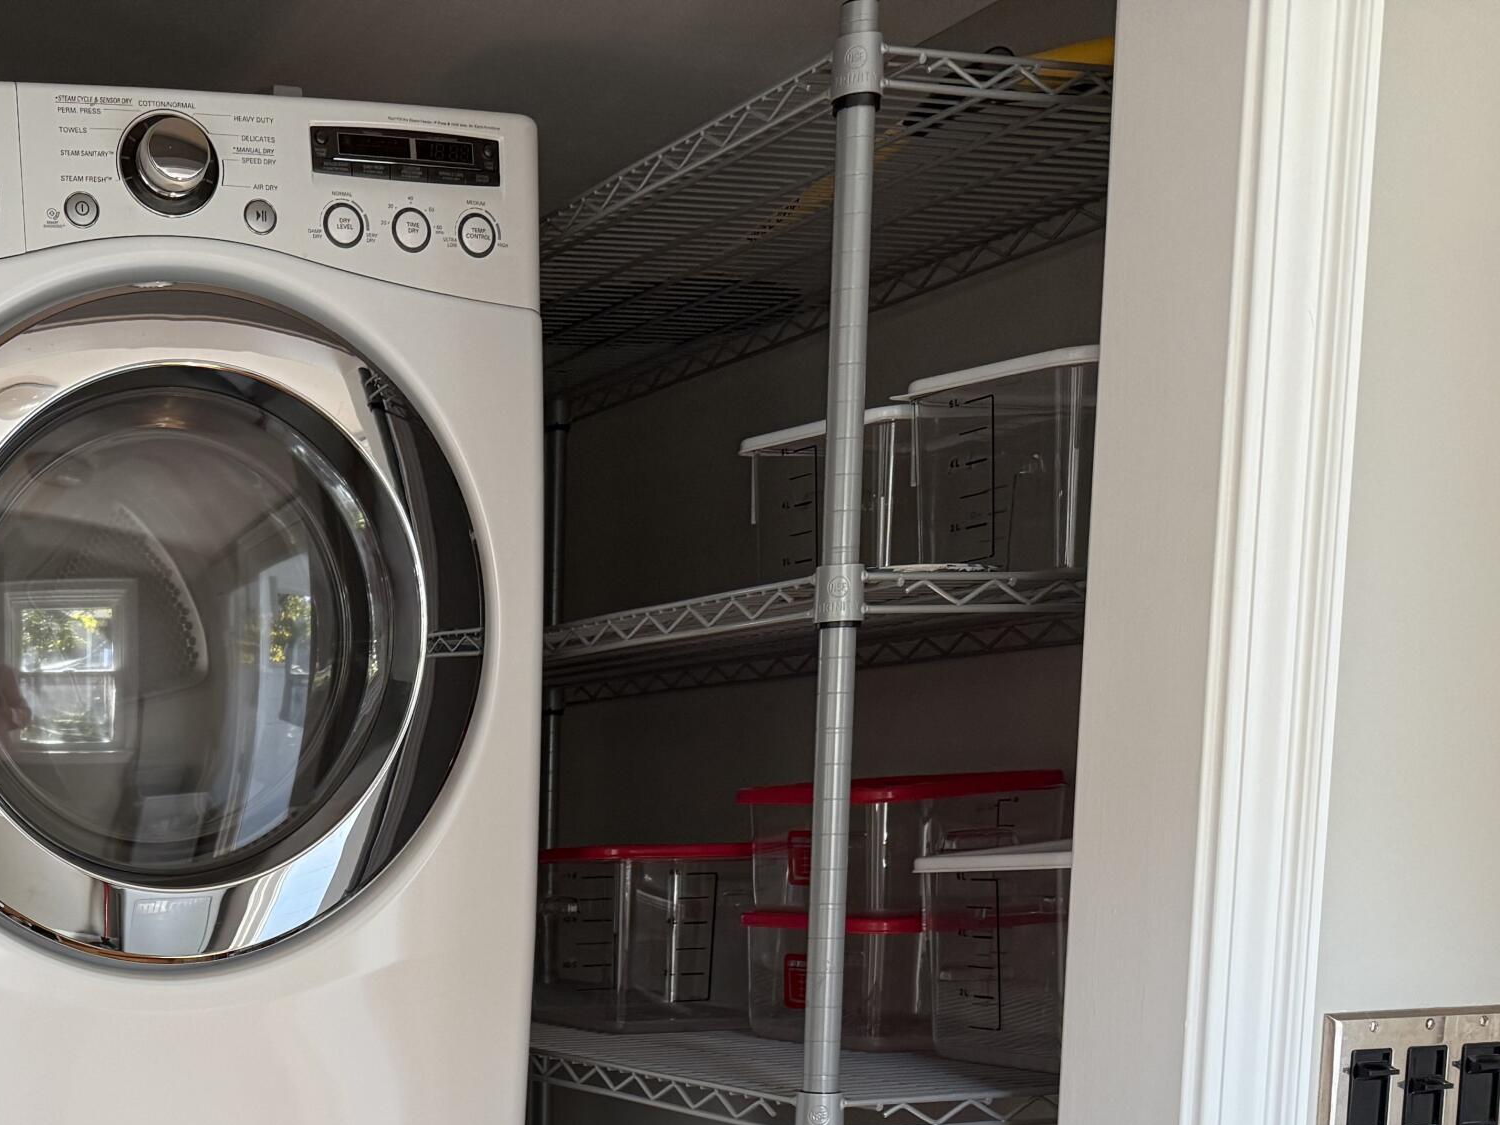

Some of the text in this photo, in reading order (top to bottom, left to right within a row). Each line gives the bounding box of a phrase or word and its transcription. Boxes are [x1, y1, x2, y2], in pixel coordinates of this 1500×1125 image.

[256, 116, 274, 124] DUTY
[241, 135, 275, 143] DELICATES
[241, 157, 262, 165] SPEED
[466, 233, 491, 241] CONTROL
